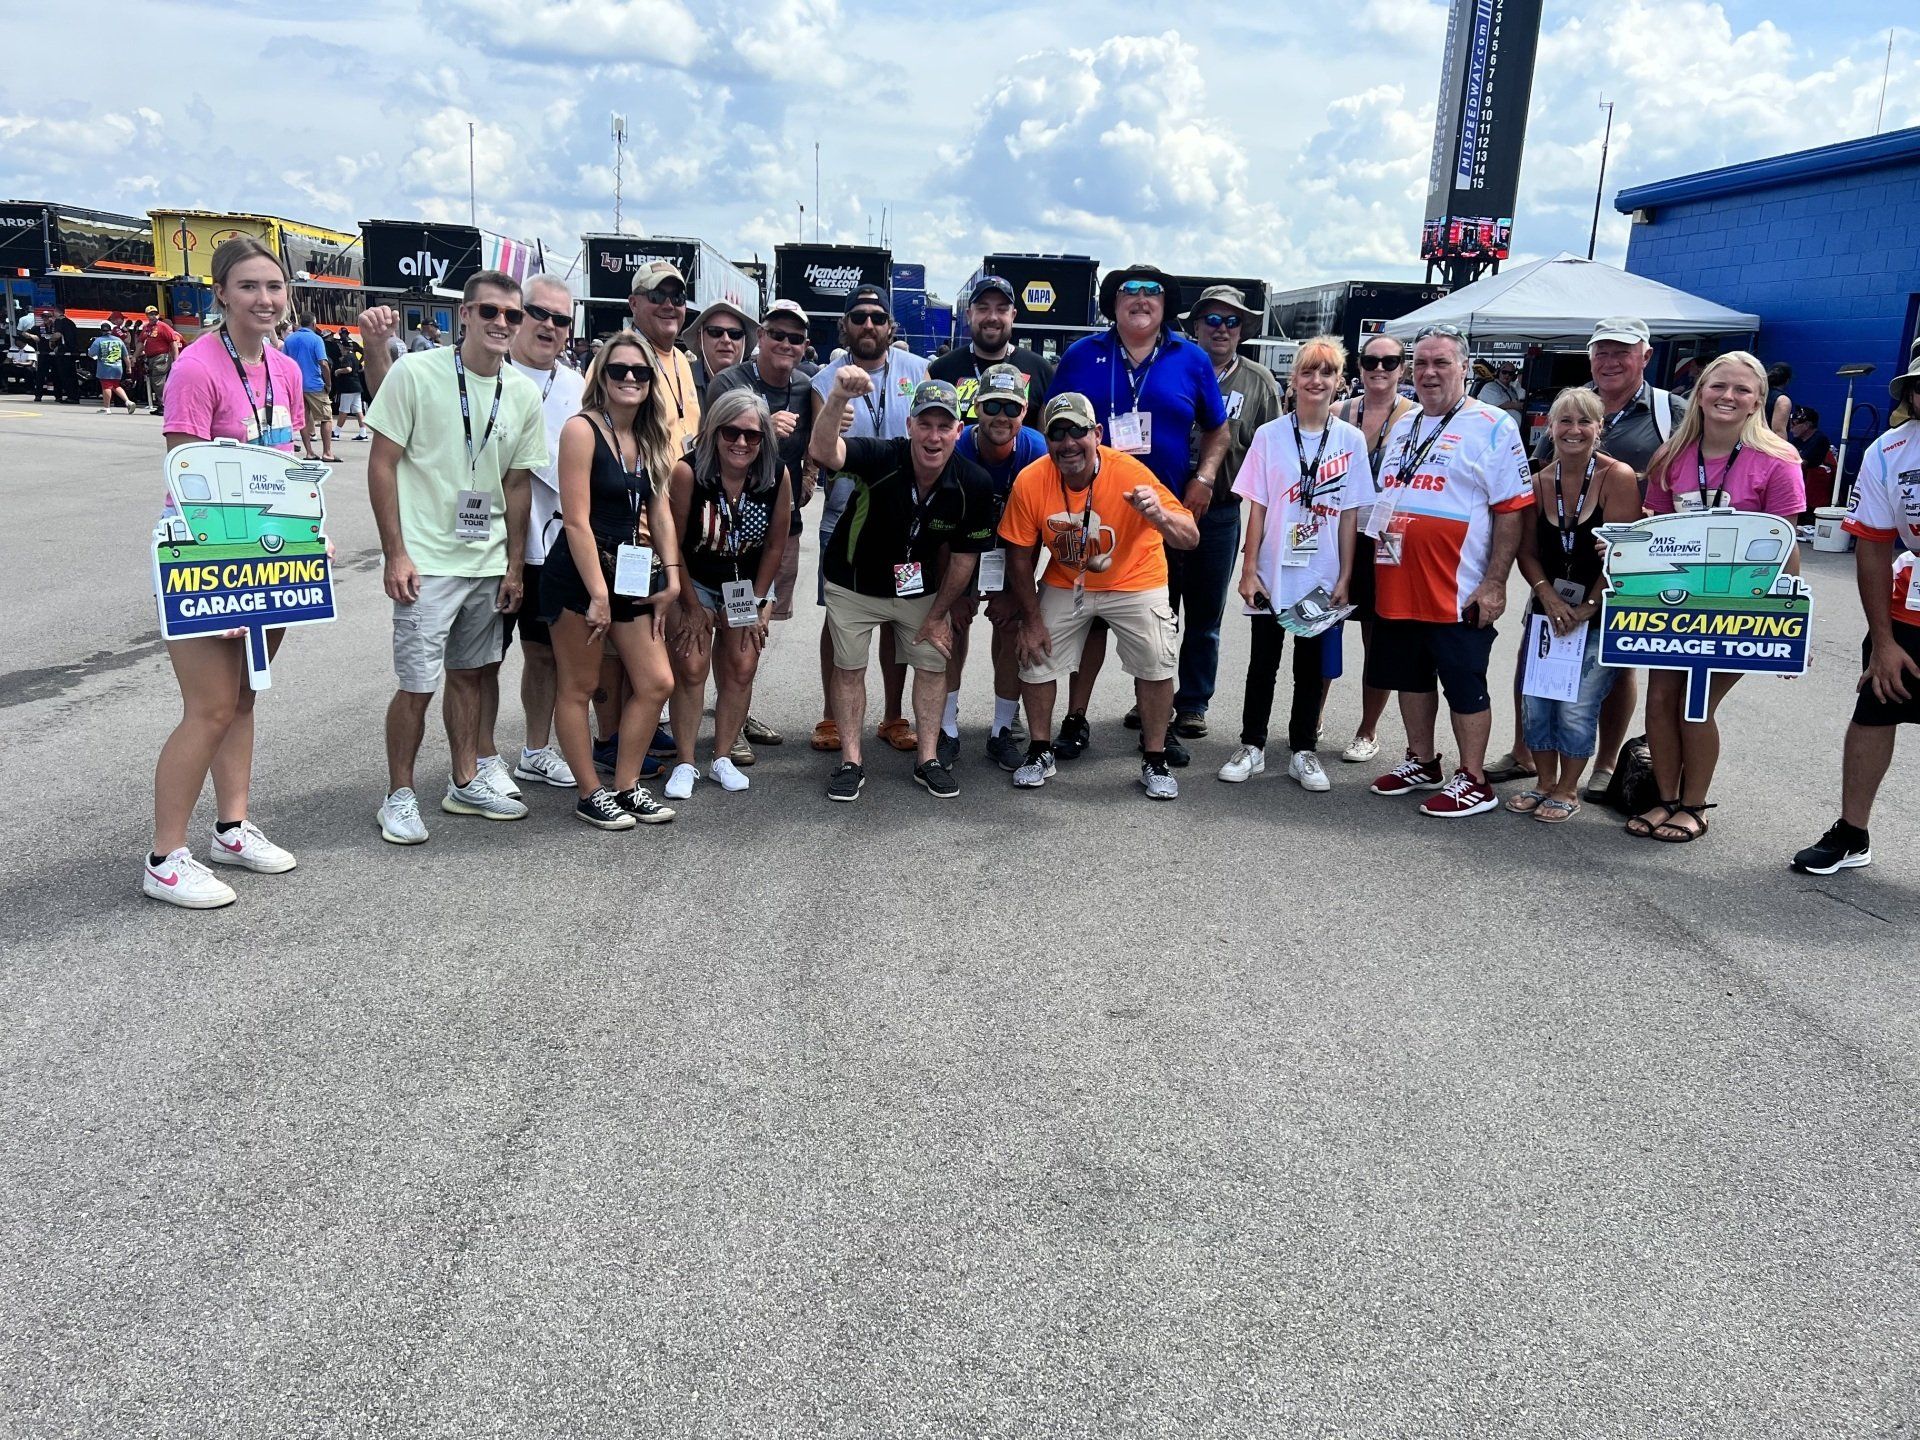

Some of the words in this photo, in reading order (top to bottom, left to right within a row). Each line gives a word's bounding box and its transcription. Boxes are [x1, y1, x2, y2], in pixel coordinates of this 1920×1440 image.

[1497, 0, 1503, 8] 2
[1495, 12, 1502, 23] 3
[1493, 26, 1500, 37] 4
[1492, 40, 1499, 51] 5
[1490, 54, 1497, 65] 6
[1489, 68, 1495, 78] 7
[1486, 82, 1493, 93] 8
[1461, 23, 1487, 169] MISPEEDWAY.com
[1485, 96, 1492, 107] 9
[1481, 109, 1493, 121] 10
[1480, 123, 1491, 134] 11
[1477, 137, 1489, 148] 12
[1476, 150, 1488, 161] 13
[1474, 164, 1486, 175] 14
[1472, 178, 1484, 189] 15
[310, 249, 353, 278] TEAM
[398, 251, 450, 284] ally
[804, 263, 864, 283] Hendrick
[815, 278, 859, 288] cars.com
[1027, 289, 1051, 304] NAPA
[252, 474, 268, 482] MIS
[250, 482, 286, 491] CAMPING
[459, 512, 489, 521] GARAGE
[463, 519, 484, 527] TOUR
[1652, 536, 1676, 545] MIS
[1648, 544, 1702, 553] CAMPING
[166, 565, 220, 594] MIS
[222, 559, 325, 589] CAMPING
[179, 592, 267, 618] GARAGE
[270, 587, 325, 609] TOUR
[727, 599, 754, 609] GARAGE
[731, 606, 751, 614] TOUR
[1609, 611, 1668, 632] MIS
[1671, 613, 1804, 638] CAMPING
[1616, 636, 1716, 655] GARAGE
[1721, 640, 1792, 659] TOUR
